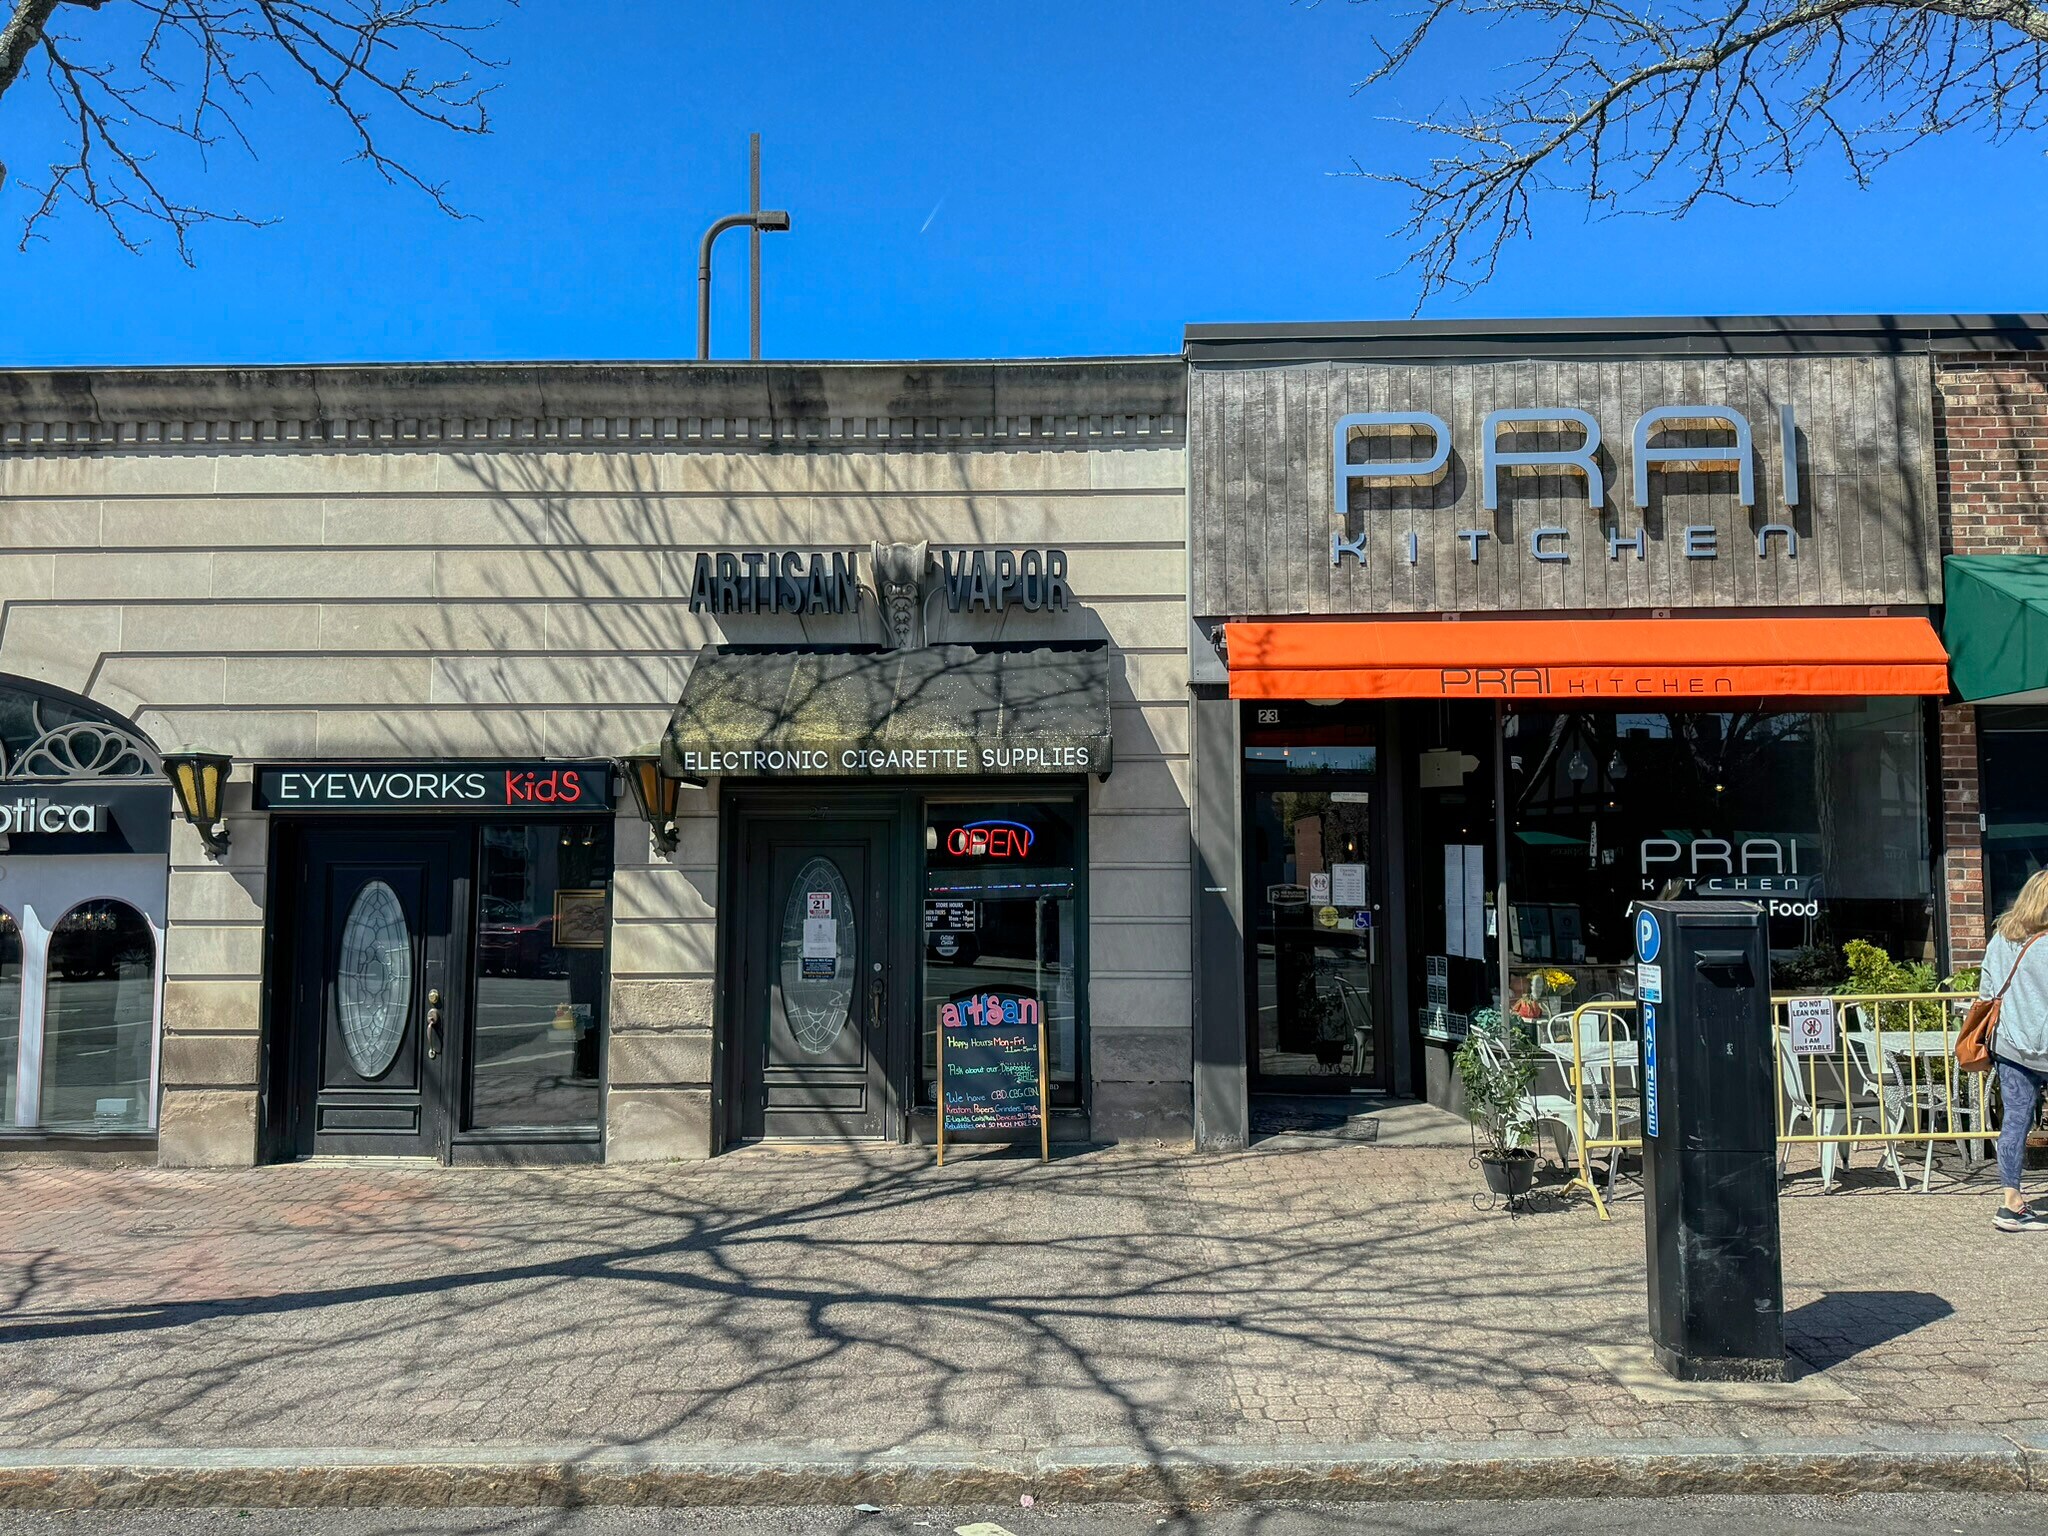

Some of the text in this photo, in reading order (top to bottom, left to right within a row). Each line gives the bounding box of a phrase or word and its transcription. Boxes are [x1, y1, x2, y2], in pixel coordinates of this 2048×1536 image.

[1334, 404, 1800, 514] PRAI
[689, 549, 1069, 614] ARTISAN VAPOR
[1441, 667, 1551, 694] PRAI
[1260, 710, 1277, 722] 23
[685, 747, 1090, 770] ELECTRONIC CIGARETTE SUPPLIES
[280, 773, 486, 799] EYEWORKS
[947, 828, 1030, 858] OPEN
[1640, 839, 1798, 875] PRAI
[813, 900, 825, 909] 21
[1769, 899, 1819, 917] Food
[1641, 919, 1653, 954] P
[942, 993, 1039, 1027] artisan
[947, 1036, 969, 1049] Happy
[1645, 1009, 1653, 1058] PAY
[947, 1063, 964, 1076] Ask
[965, 1066, 985, 1074] about
[946, 1091, 964, 1103] We
[966, 1092, 987, 1102] have
[1647, 1064, 1656, 1131] HERE
